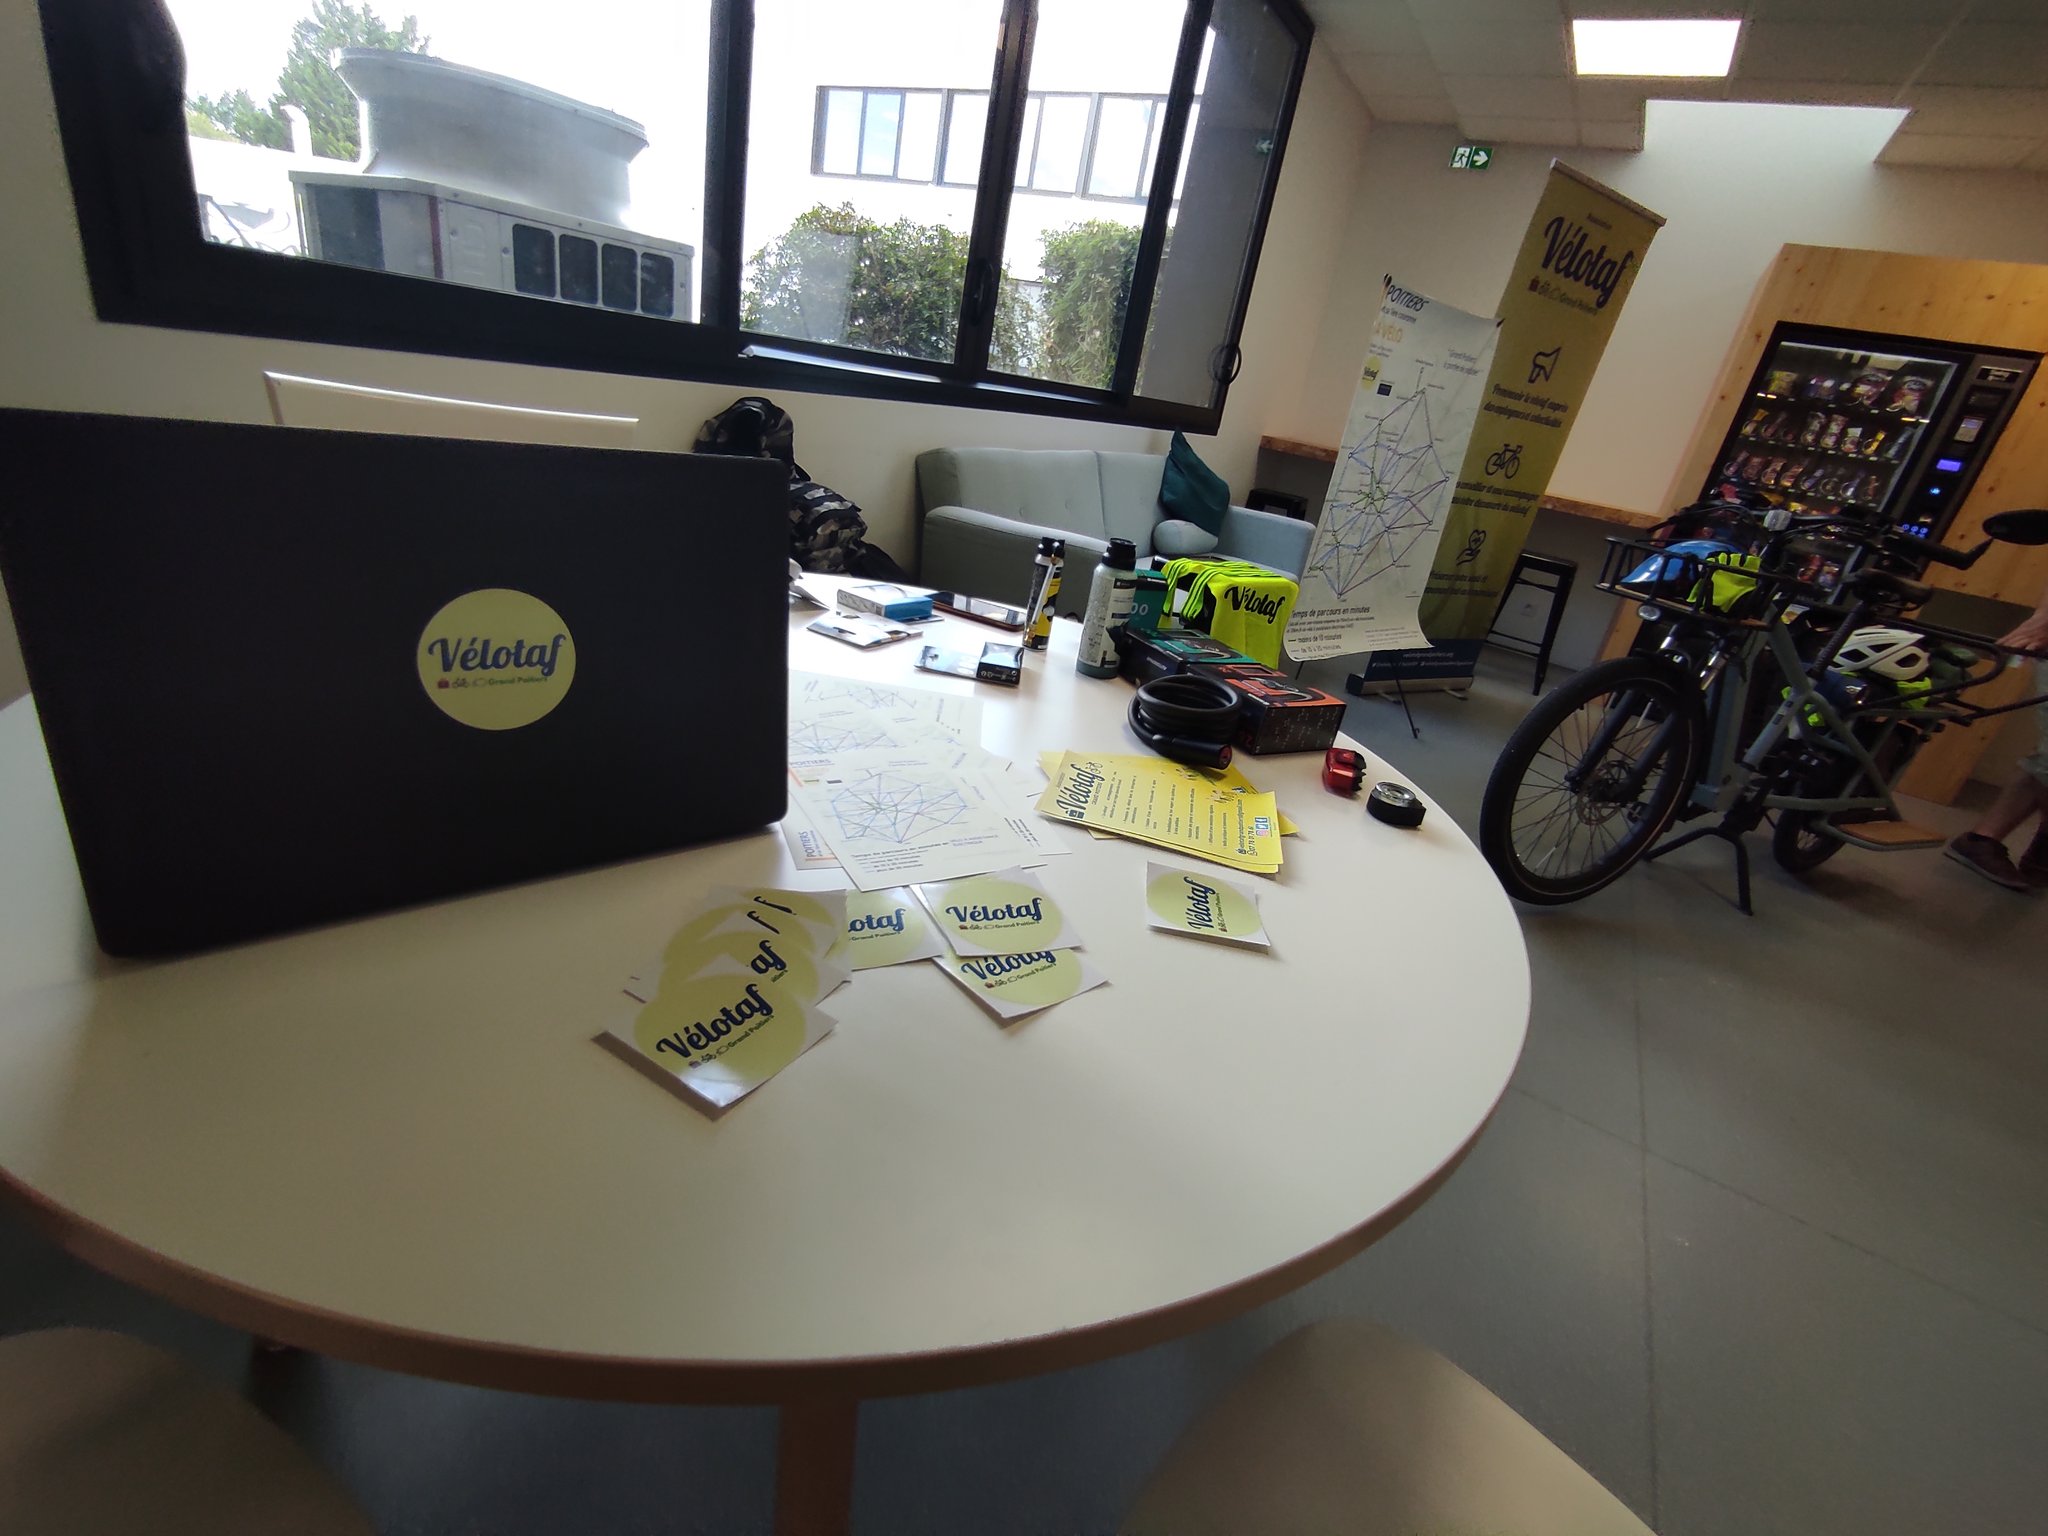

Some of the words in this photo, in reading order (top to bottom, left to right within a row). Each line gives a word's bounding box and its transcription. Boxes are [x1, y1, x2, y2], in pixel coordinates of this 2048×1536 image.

[1542, 216, 1634, 309] Vélotaf
[1385, 284, 1430, 312] POITIERS
[1316, 608, 1341, 619] parcours
[1342, 607, 1349, 615] en
[1350, 606, 1370, 614] minutes
[428, 633, 566, 676] Vélotaf
[1056, 764, 1105, 810] Vélotaf
[848, 907, 906, 933] otaf
[946, 897, 1042, 923] Vélotaf
[1184, 876, 1217, 930] Vélotaf
[961, 950, 1057, 980] Vélotaf
[656, 983, 774, 1060] Vélotaf
[728, 1031, 751, 1048] Grand
[748, 1014, 775, 1036] Poitiers
